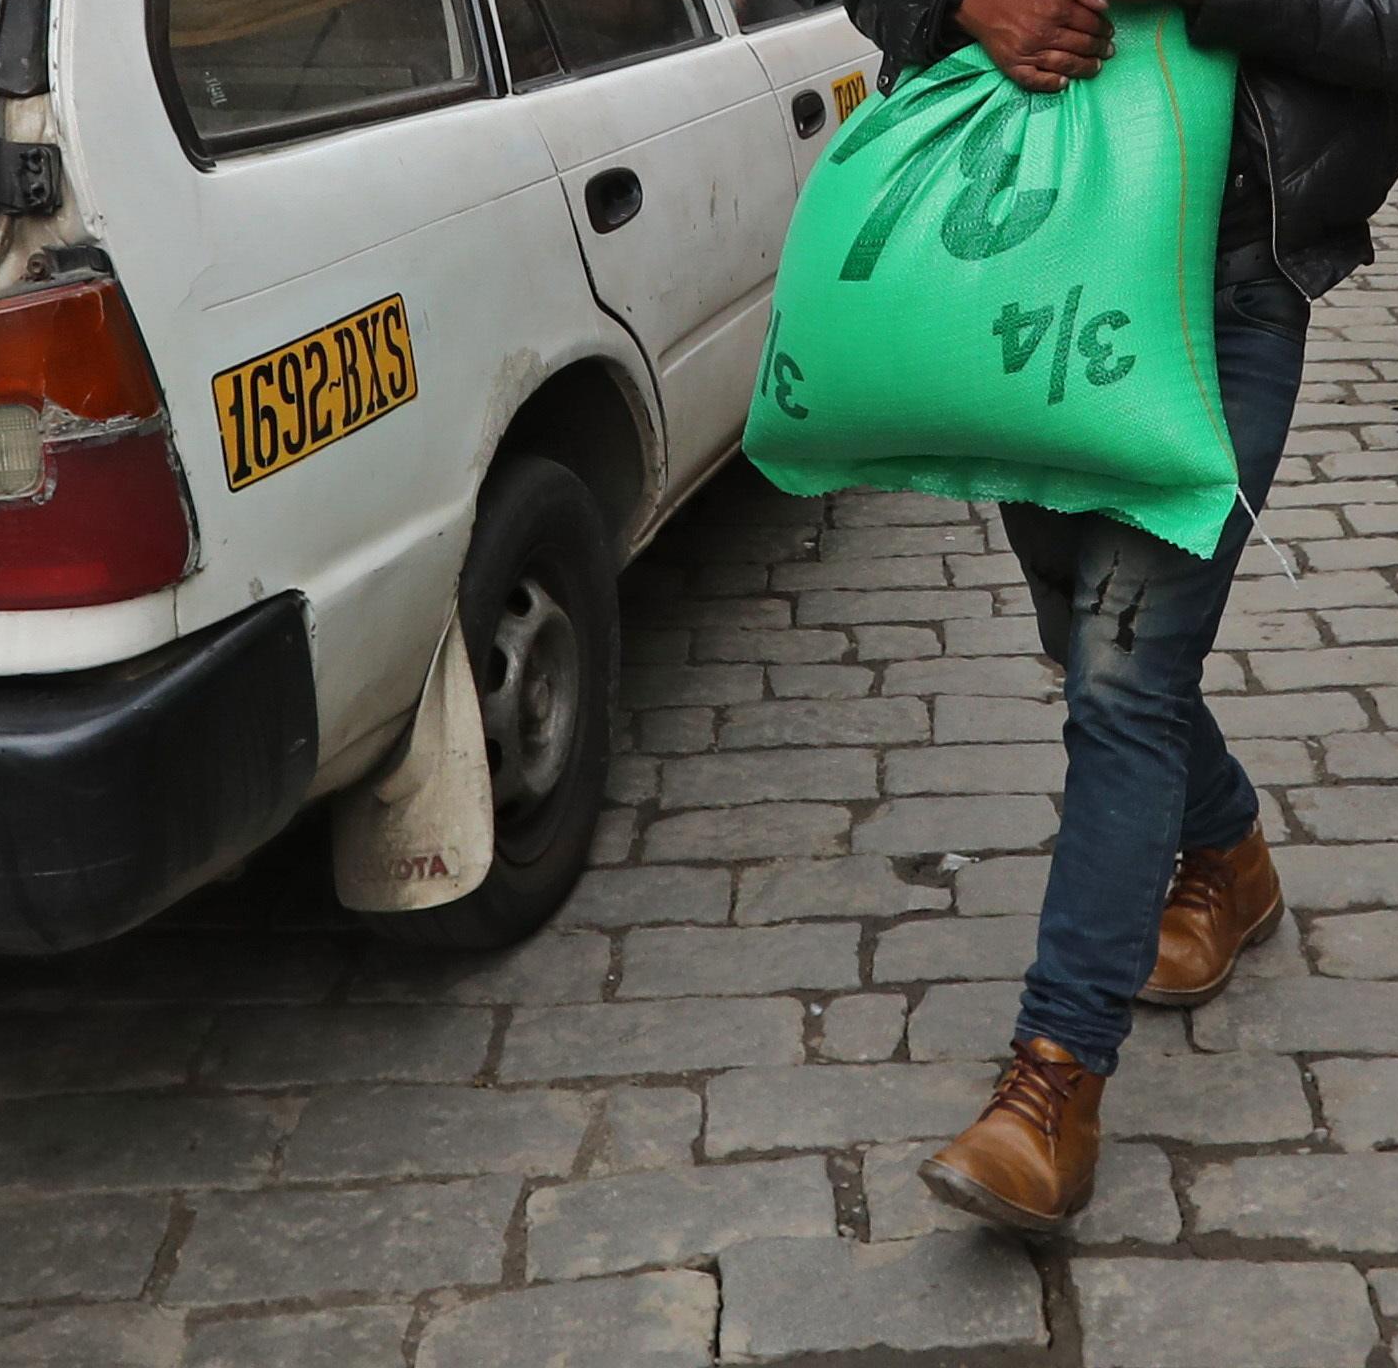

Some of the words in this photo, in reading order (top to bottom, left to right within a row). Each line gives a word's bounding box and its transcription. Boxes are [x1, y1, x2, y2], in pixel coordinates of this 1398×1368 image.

[834, 76, 866, 124] TAXI
[992, 285, 1137, 407] 3/4
[225, 304, 411, 482] 1692-BXS
[391, 854, 449, 881] OTA
